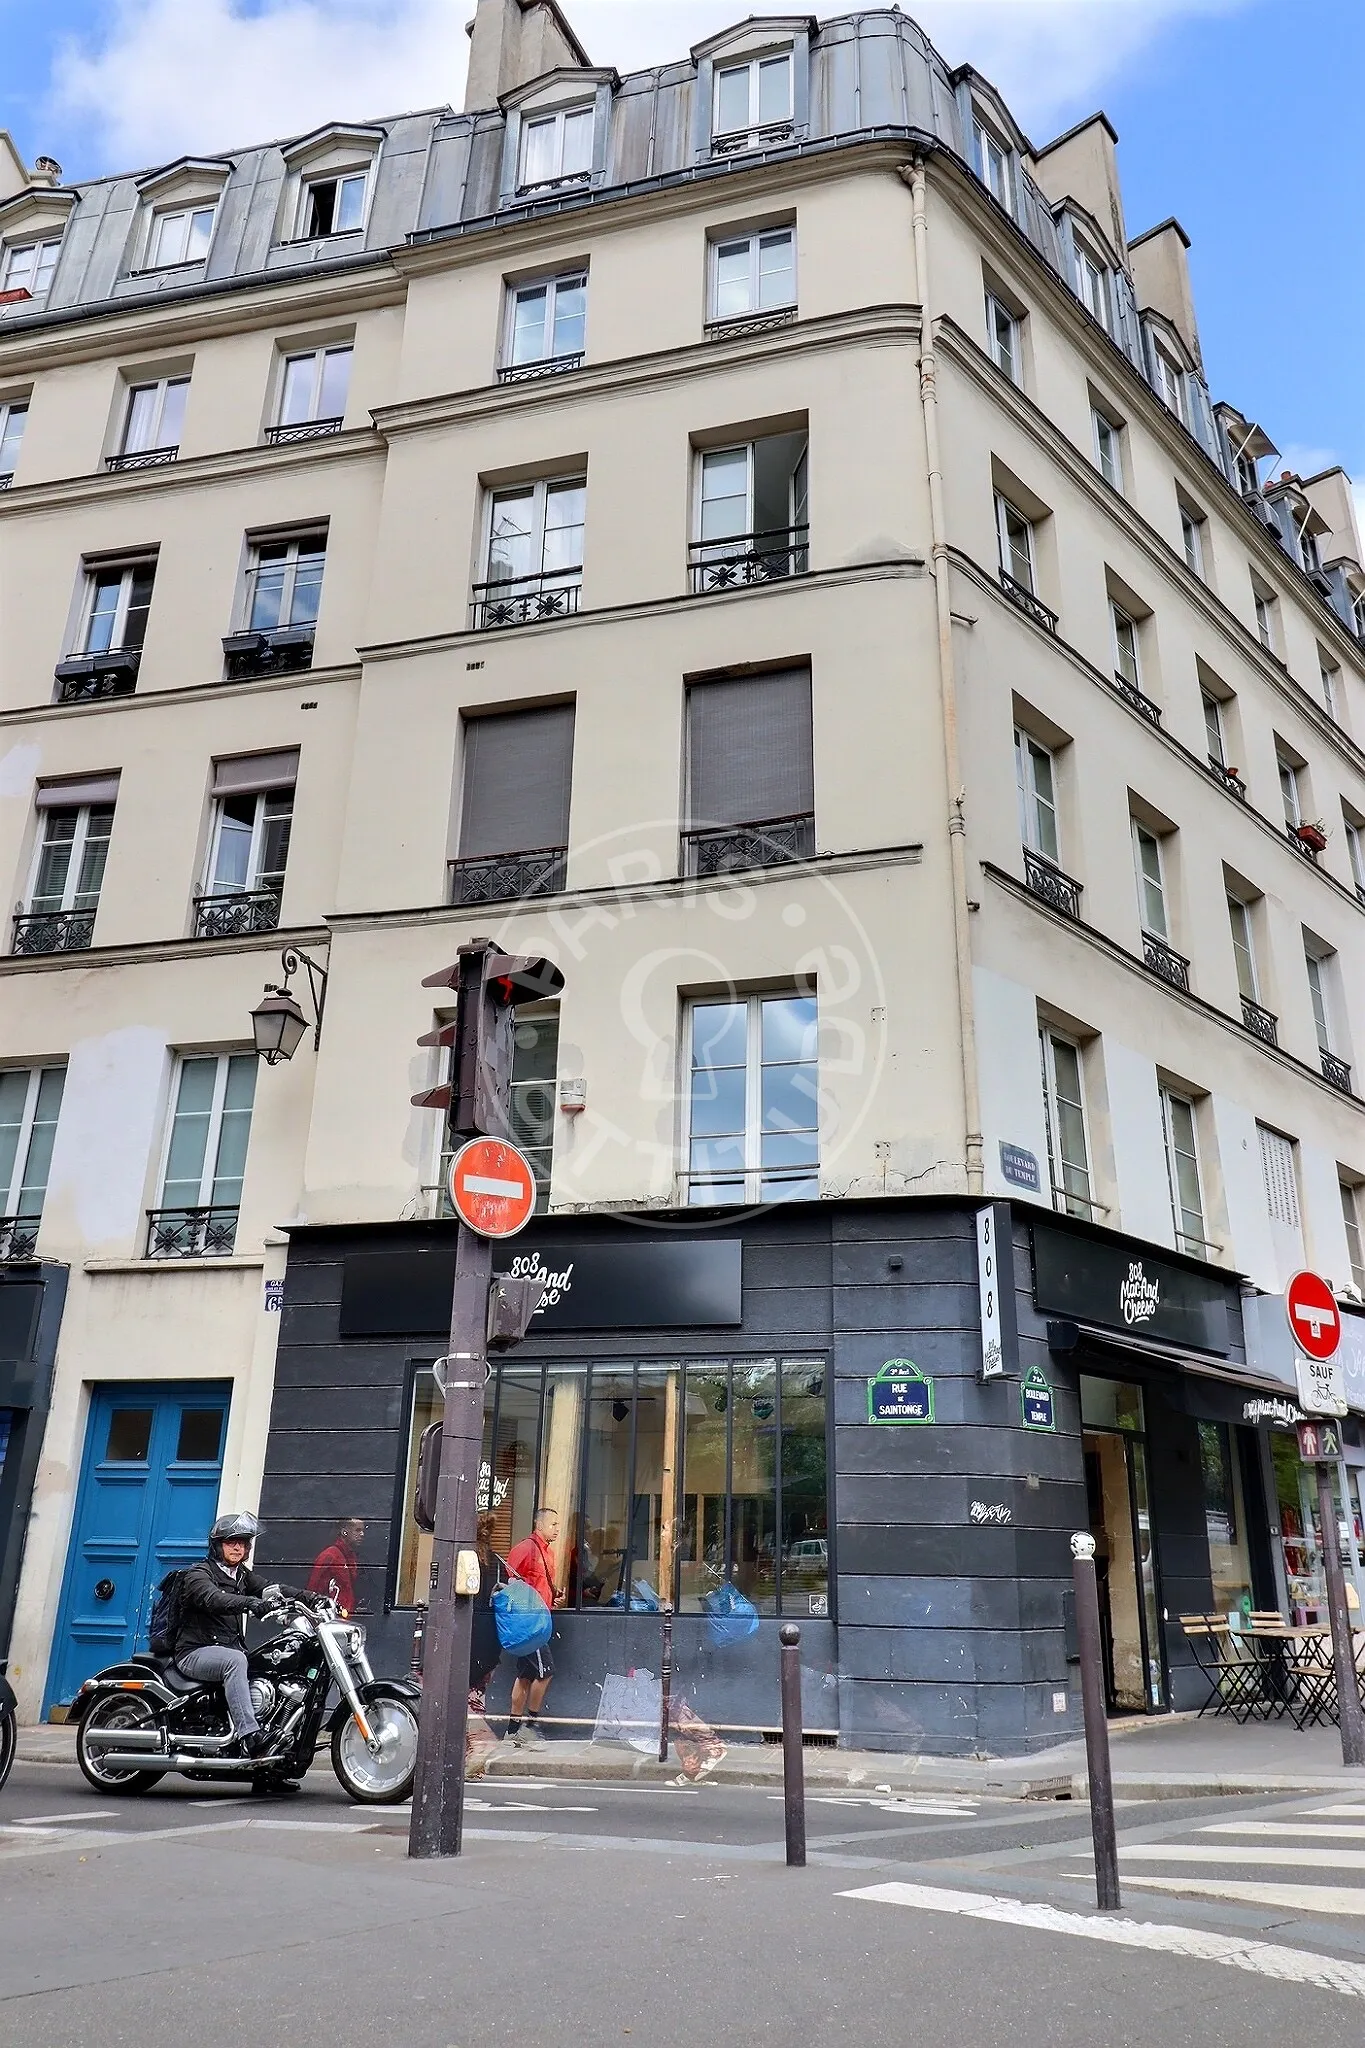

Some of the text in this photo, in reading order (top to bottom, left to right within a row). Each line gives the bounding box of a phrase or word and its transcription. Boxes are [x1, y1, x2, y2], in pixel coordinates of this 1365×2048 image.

[1003, 1152, 1036, 1171] BOULEVARD
[1014, 1168, 1036, 1183] TEMPLE
[511, 1252, 541, 1278] 808
[1129, 1261, 1143, 1282] 808
[1124, 1299, 1156, 1324] Cheese
[1309, 1364, 1333, 1380] SAUF
[891, 1383, 909, 1394] RUE
[1025, 1388, 1050, 1402] BOULEVARD
[878, 1404, 923, 1416] SAINTONGE
[1030, 1410, 1048, 1423] TEMPLE
